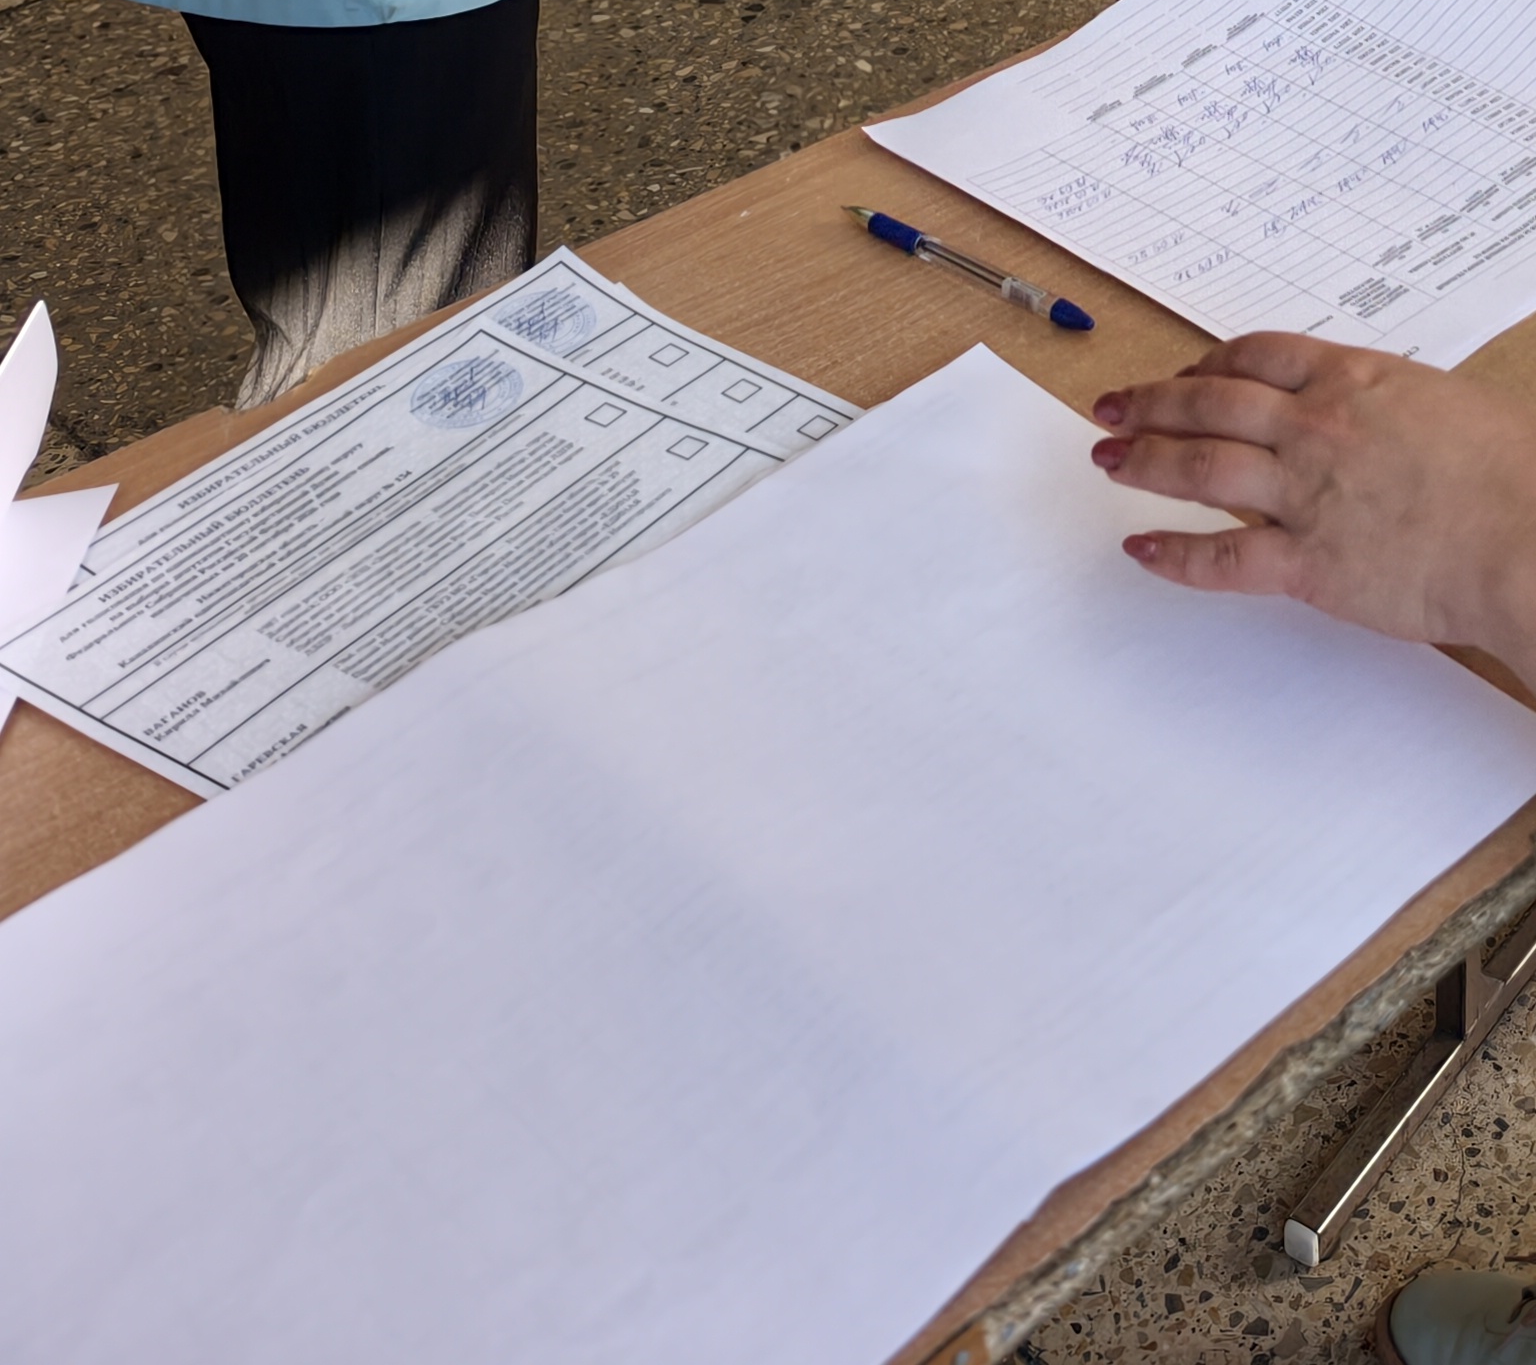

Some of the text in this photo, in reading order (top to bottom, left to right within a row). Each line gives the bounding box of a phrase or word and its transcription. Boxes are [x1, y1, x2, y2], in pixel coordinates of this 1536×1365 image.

[176, 427, 302, 516] ИЗБИРАТЕЛЬНЫЙ
[381, 479, 396, 492] №
[97, 463, 311, 605] ИЗБИРАТЕЛЬНЫЙ БЮЛЛЕТЕНЬ
[234, 550, 249, 563] 20
[142, 688, 208, 738] ВАГАНОВ
[228, 722, 311, 784] ГАРЕВСКАЯ
